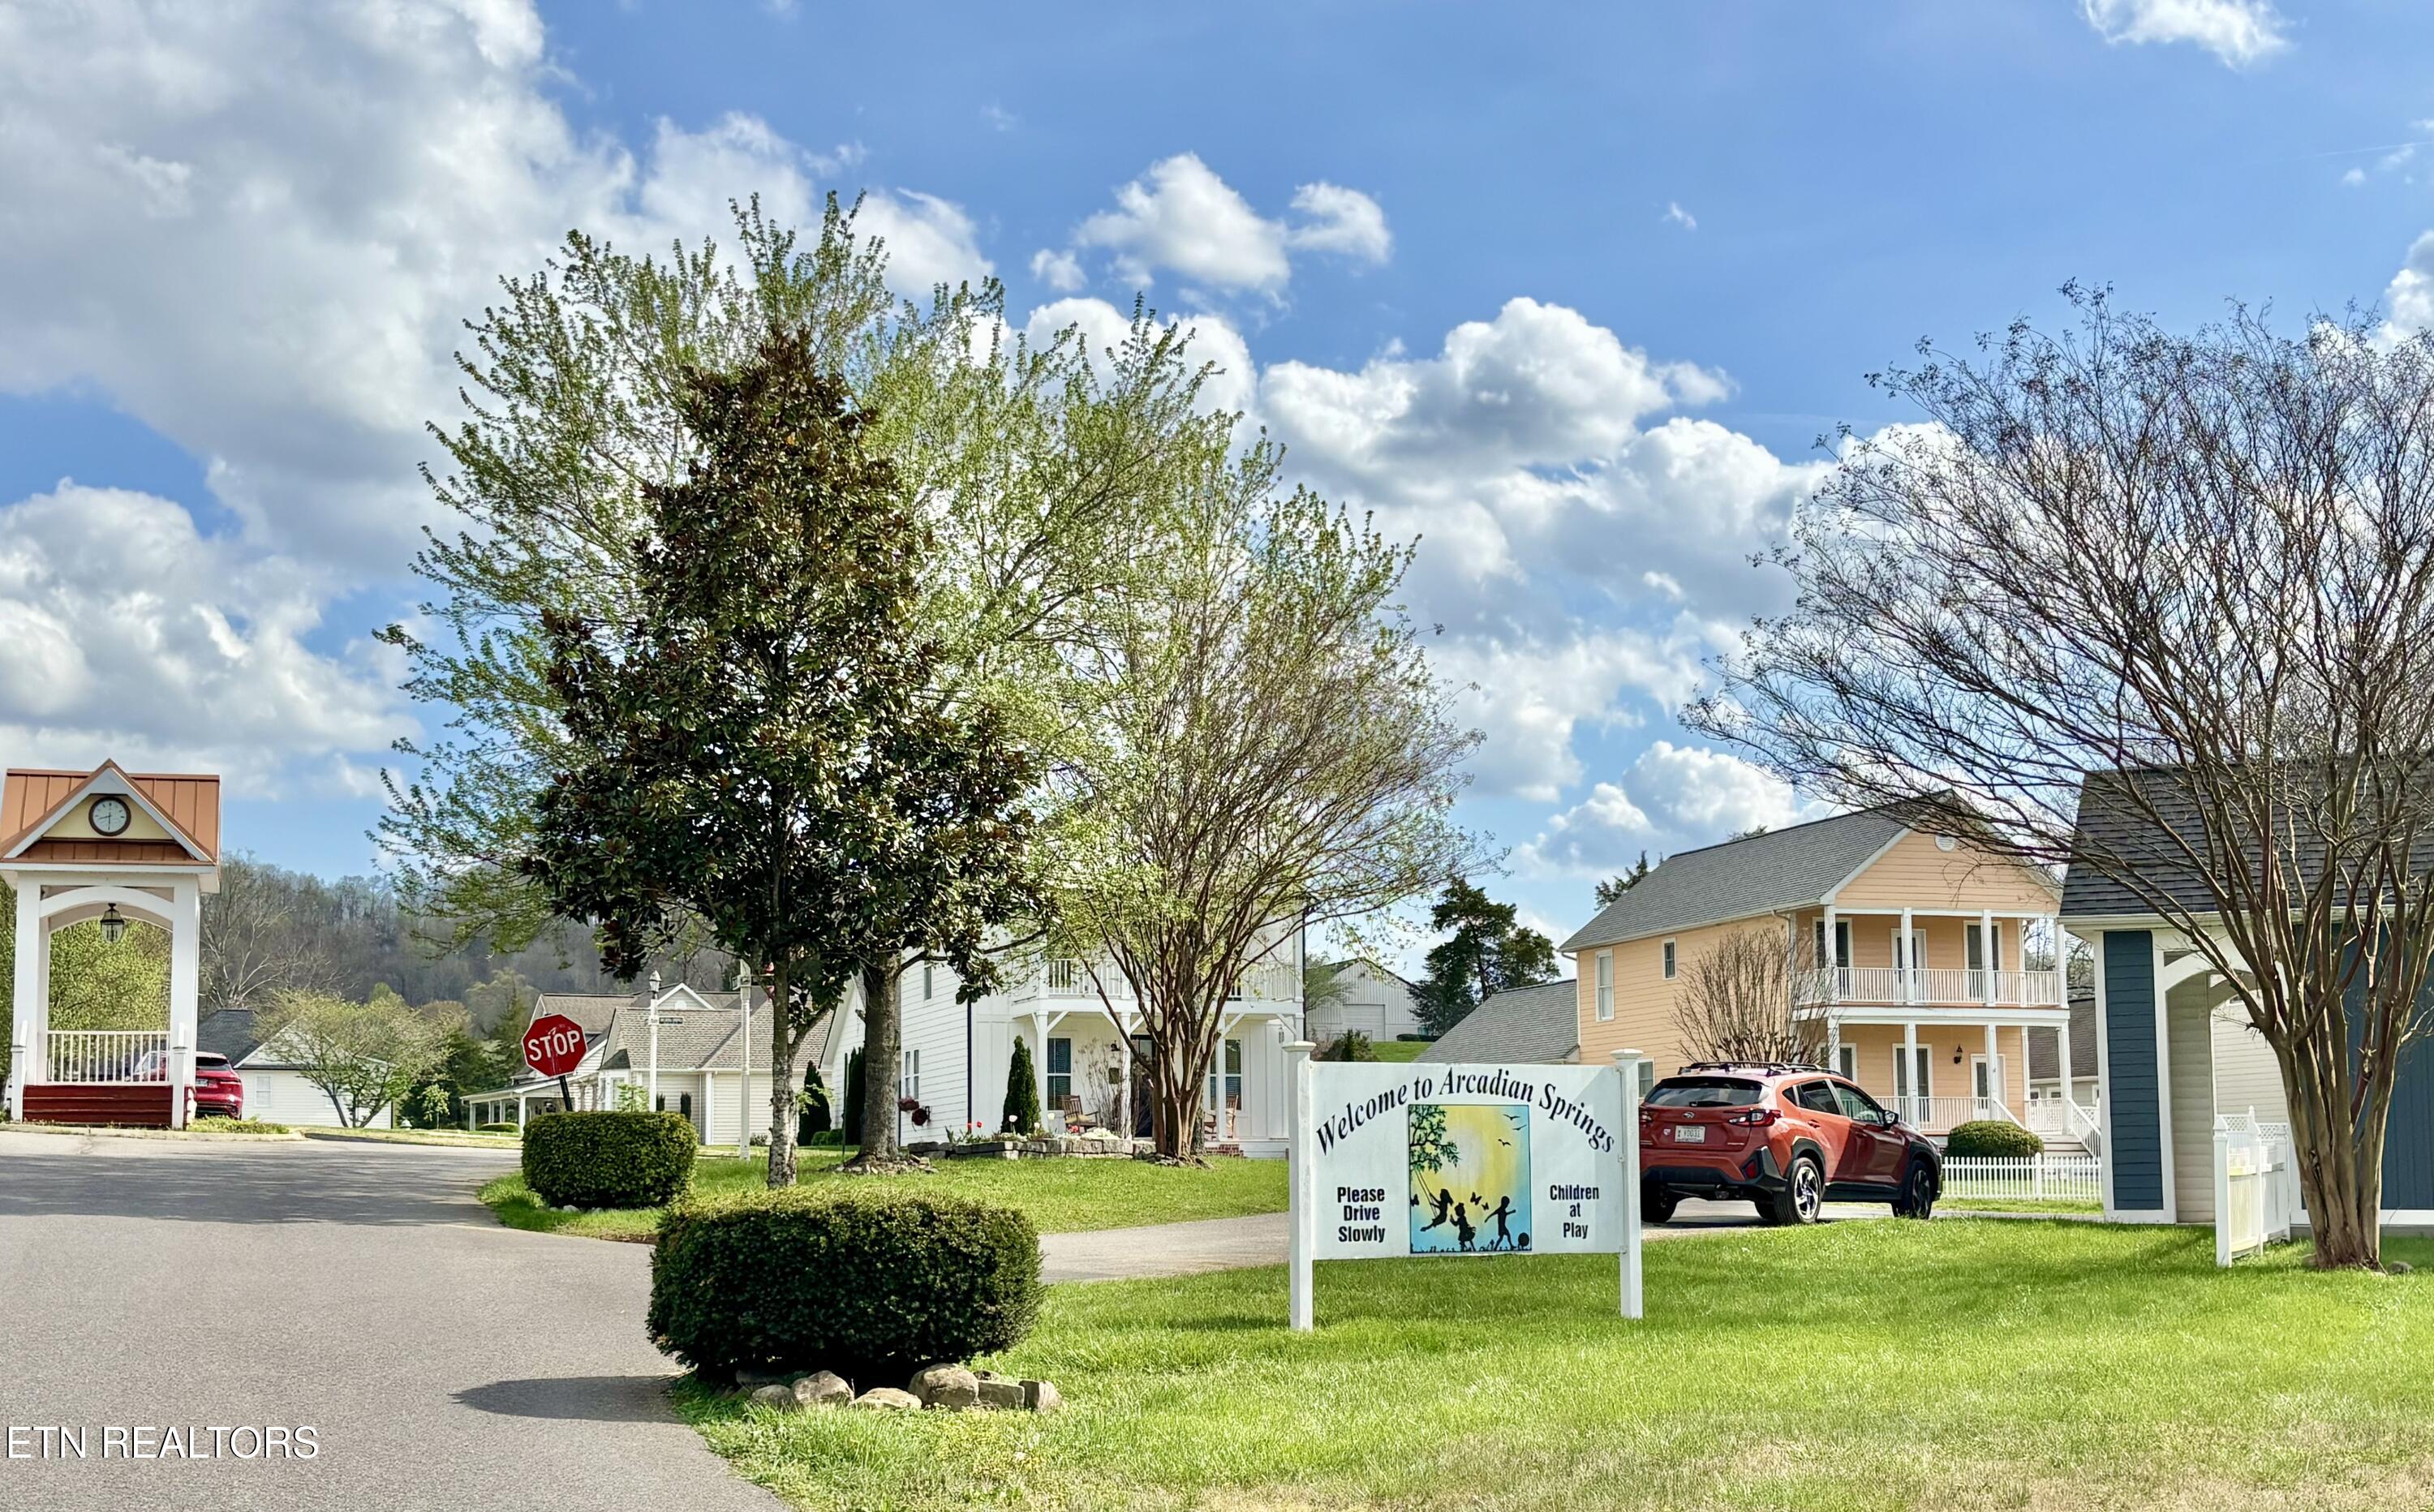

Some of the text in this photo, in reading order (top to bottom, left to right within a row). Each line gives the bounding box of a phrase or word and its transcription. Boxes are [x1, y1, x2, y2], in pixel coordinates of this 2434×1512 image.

[527, 1030, 580, 1061] STOP
[1316, 1067, 1615, 1156] Welcome to Arcadian Springs
[1337, 1186, 1385, 1203] Please
[1550, 1184, 1600, 1201] Children
[1343, 1205, 1380, 1222] Drive
[1569, 1202, 1581, 1218] at
[1338, 1225, 1386, 1244] Slowly
[1563, 1222, 1589, 1239] Play
